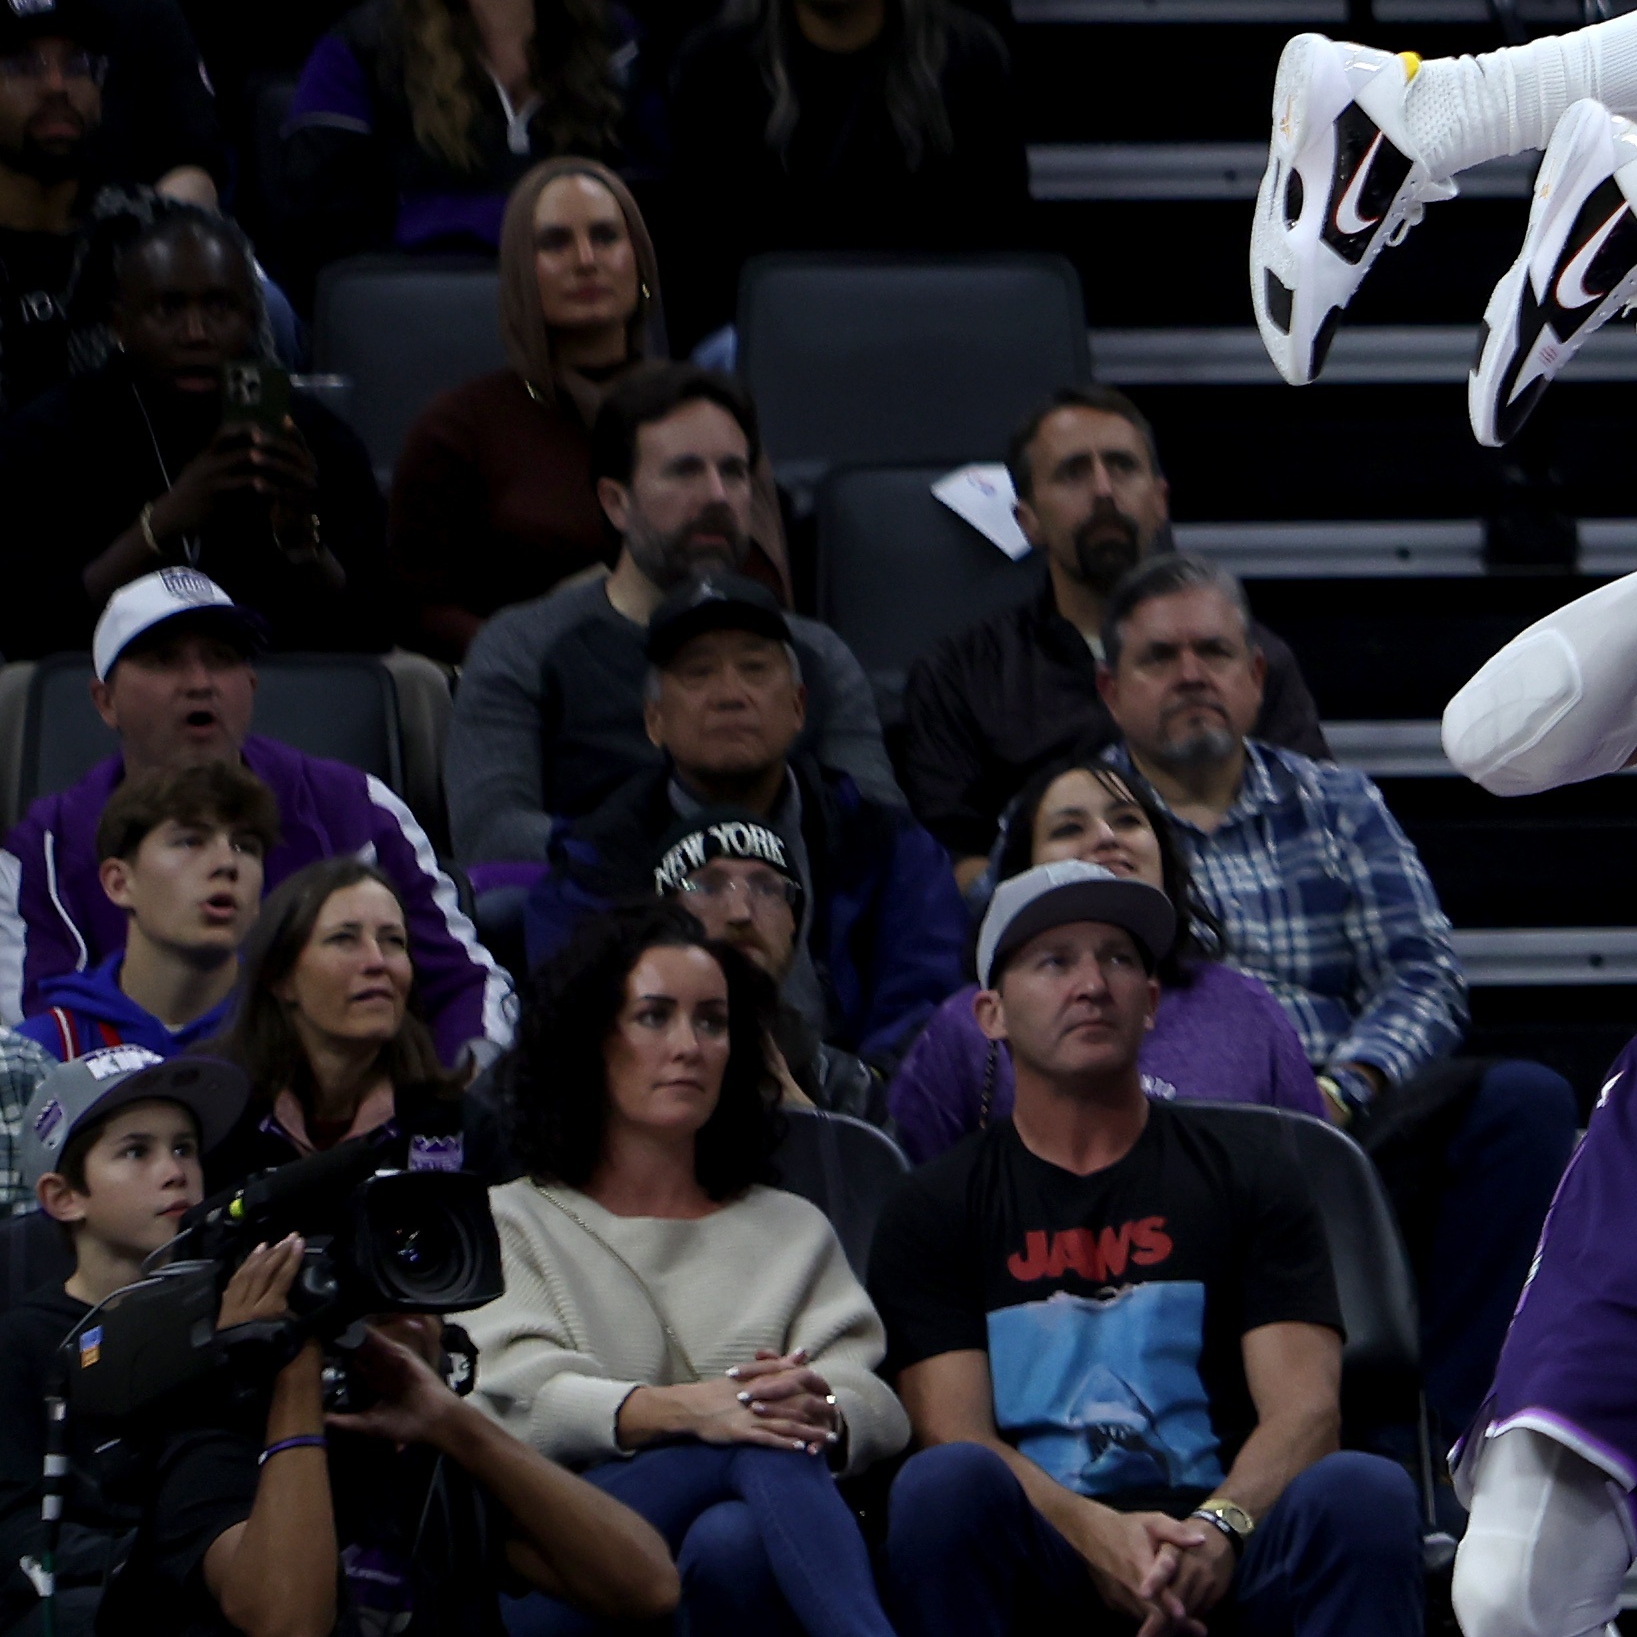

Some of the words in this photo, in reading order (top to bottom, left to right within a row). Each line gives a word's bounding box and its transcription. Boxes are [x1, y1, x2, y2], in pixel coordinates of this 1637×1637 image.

[653, 829, 707, 898] NEW
[707, 821, 788, 869] YORK
[1006, 1215, 1175, 1283] JAWS
